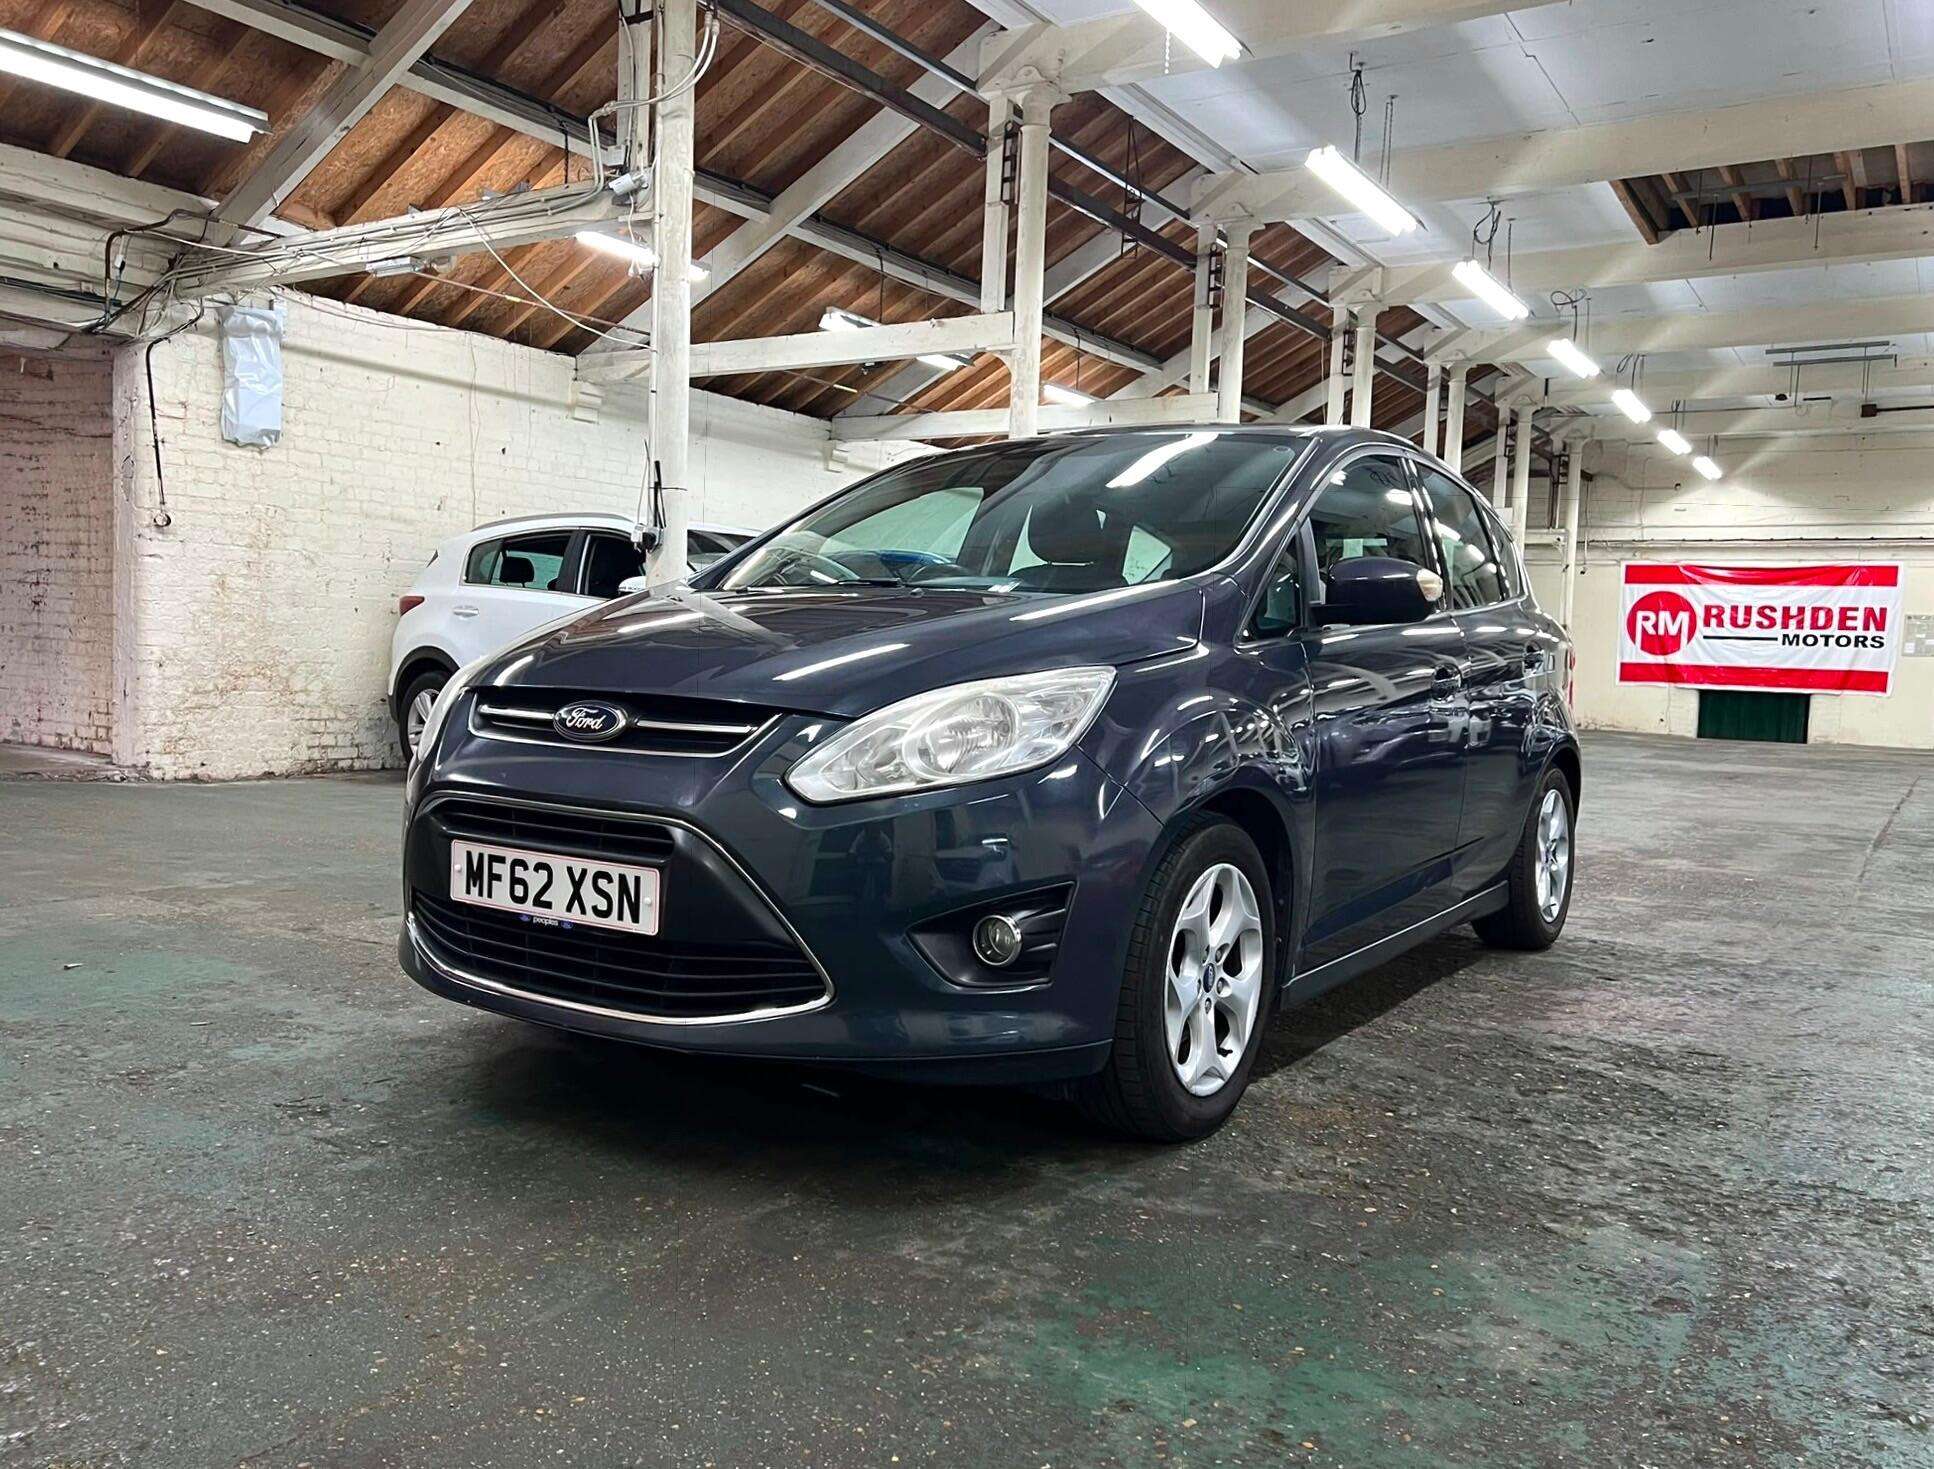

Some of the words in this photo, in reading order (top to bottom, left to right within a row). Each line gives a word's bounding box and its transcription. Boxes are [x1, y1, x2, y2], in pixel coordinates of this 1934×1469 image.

[1635, 610, 1690, 650] RM
[1703, 604, 1888, 632] RUSHDEN
[1781, 633, 1885, 649] MOTORS
[565, 707, 607, 730] Ford
[465, 850, 554, 910] MF62
[566, 866, 641, 924] XSN
